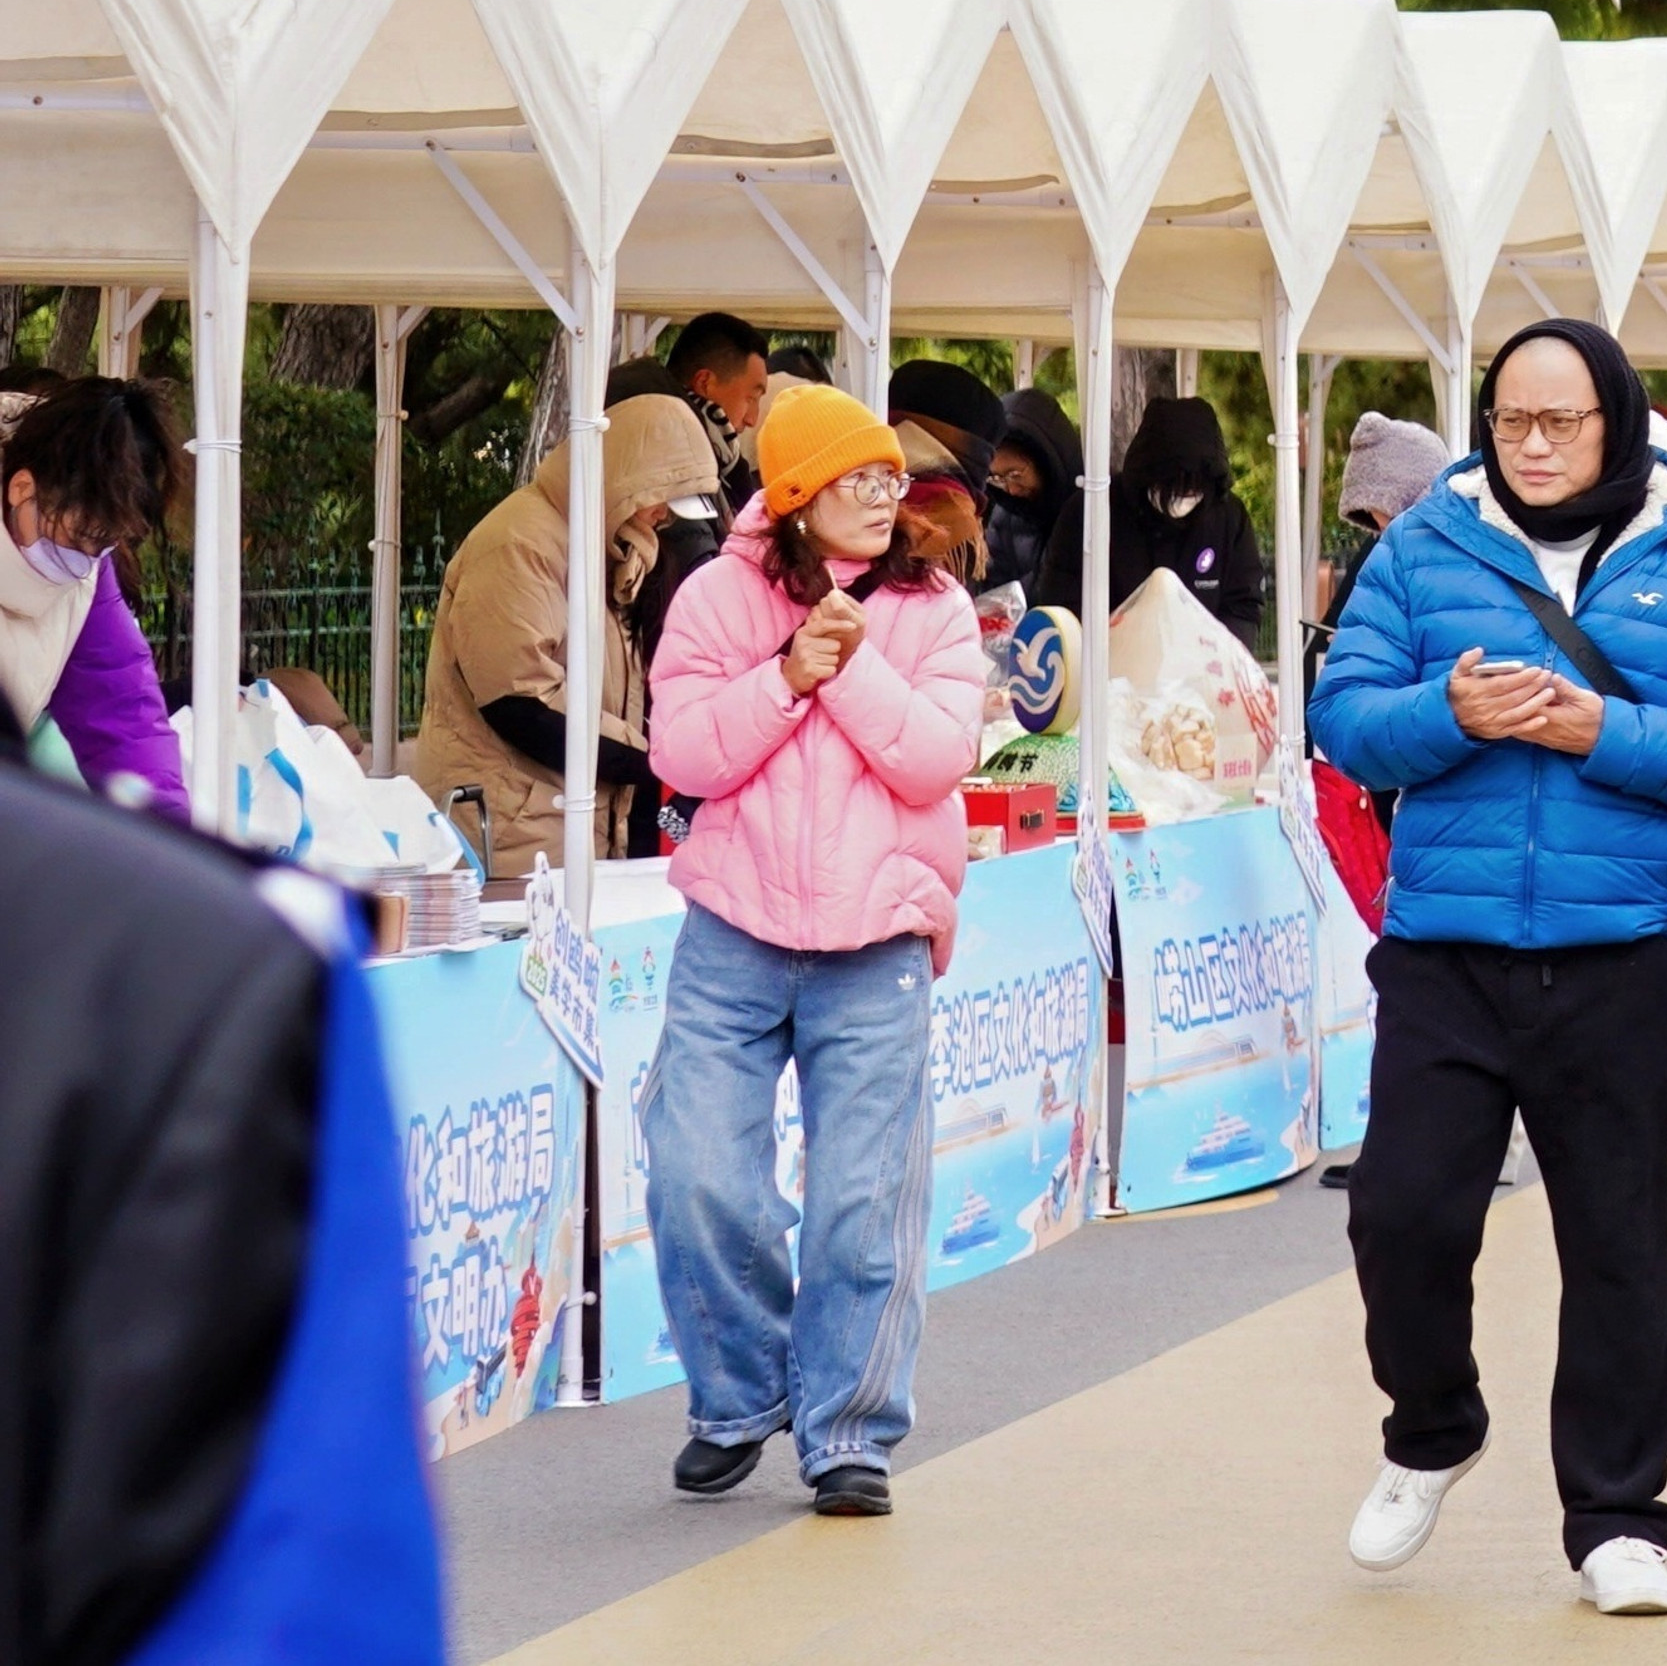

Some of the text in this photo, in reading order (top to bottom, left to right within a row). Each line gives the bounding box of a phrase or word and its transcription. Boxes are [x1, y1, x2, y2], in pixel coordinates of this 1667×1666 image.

[1154, 911, 1313, 1032] 崂山区文化和旅游局
